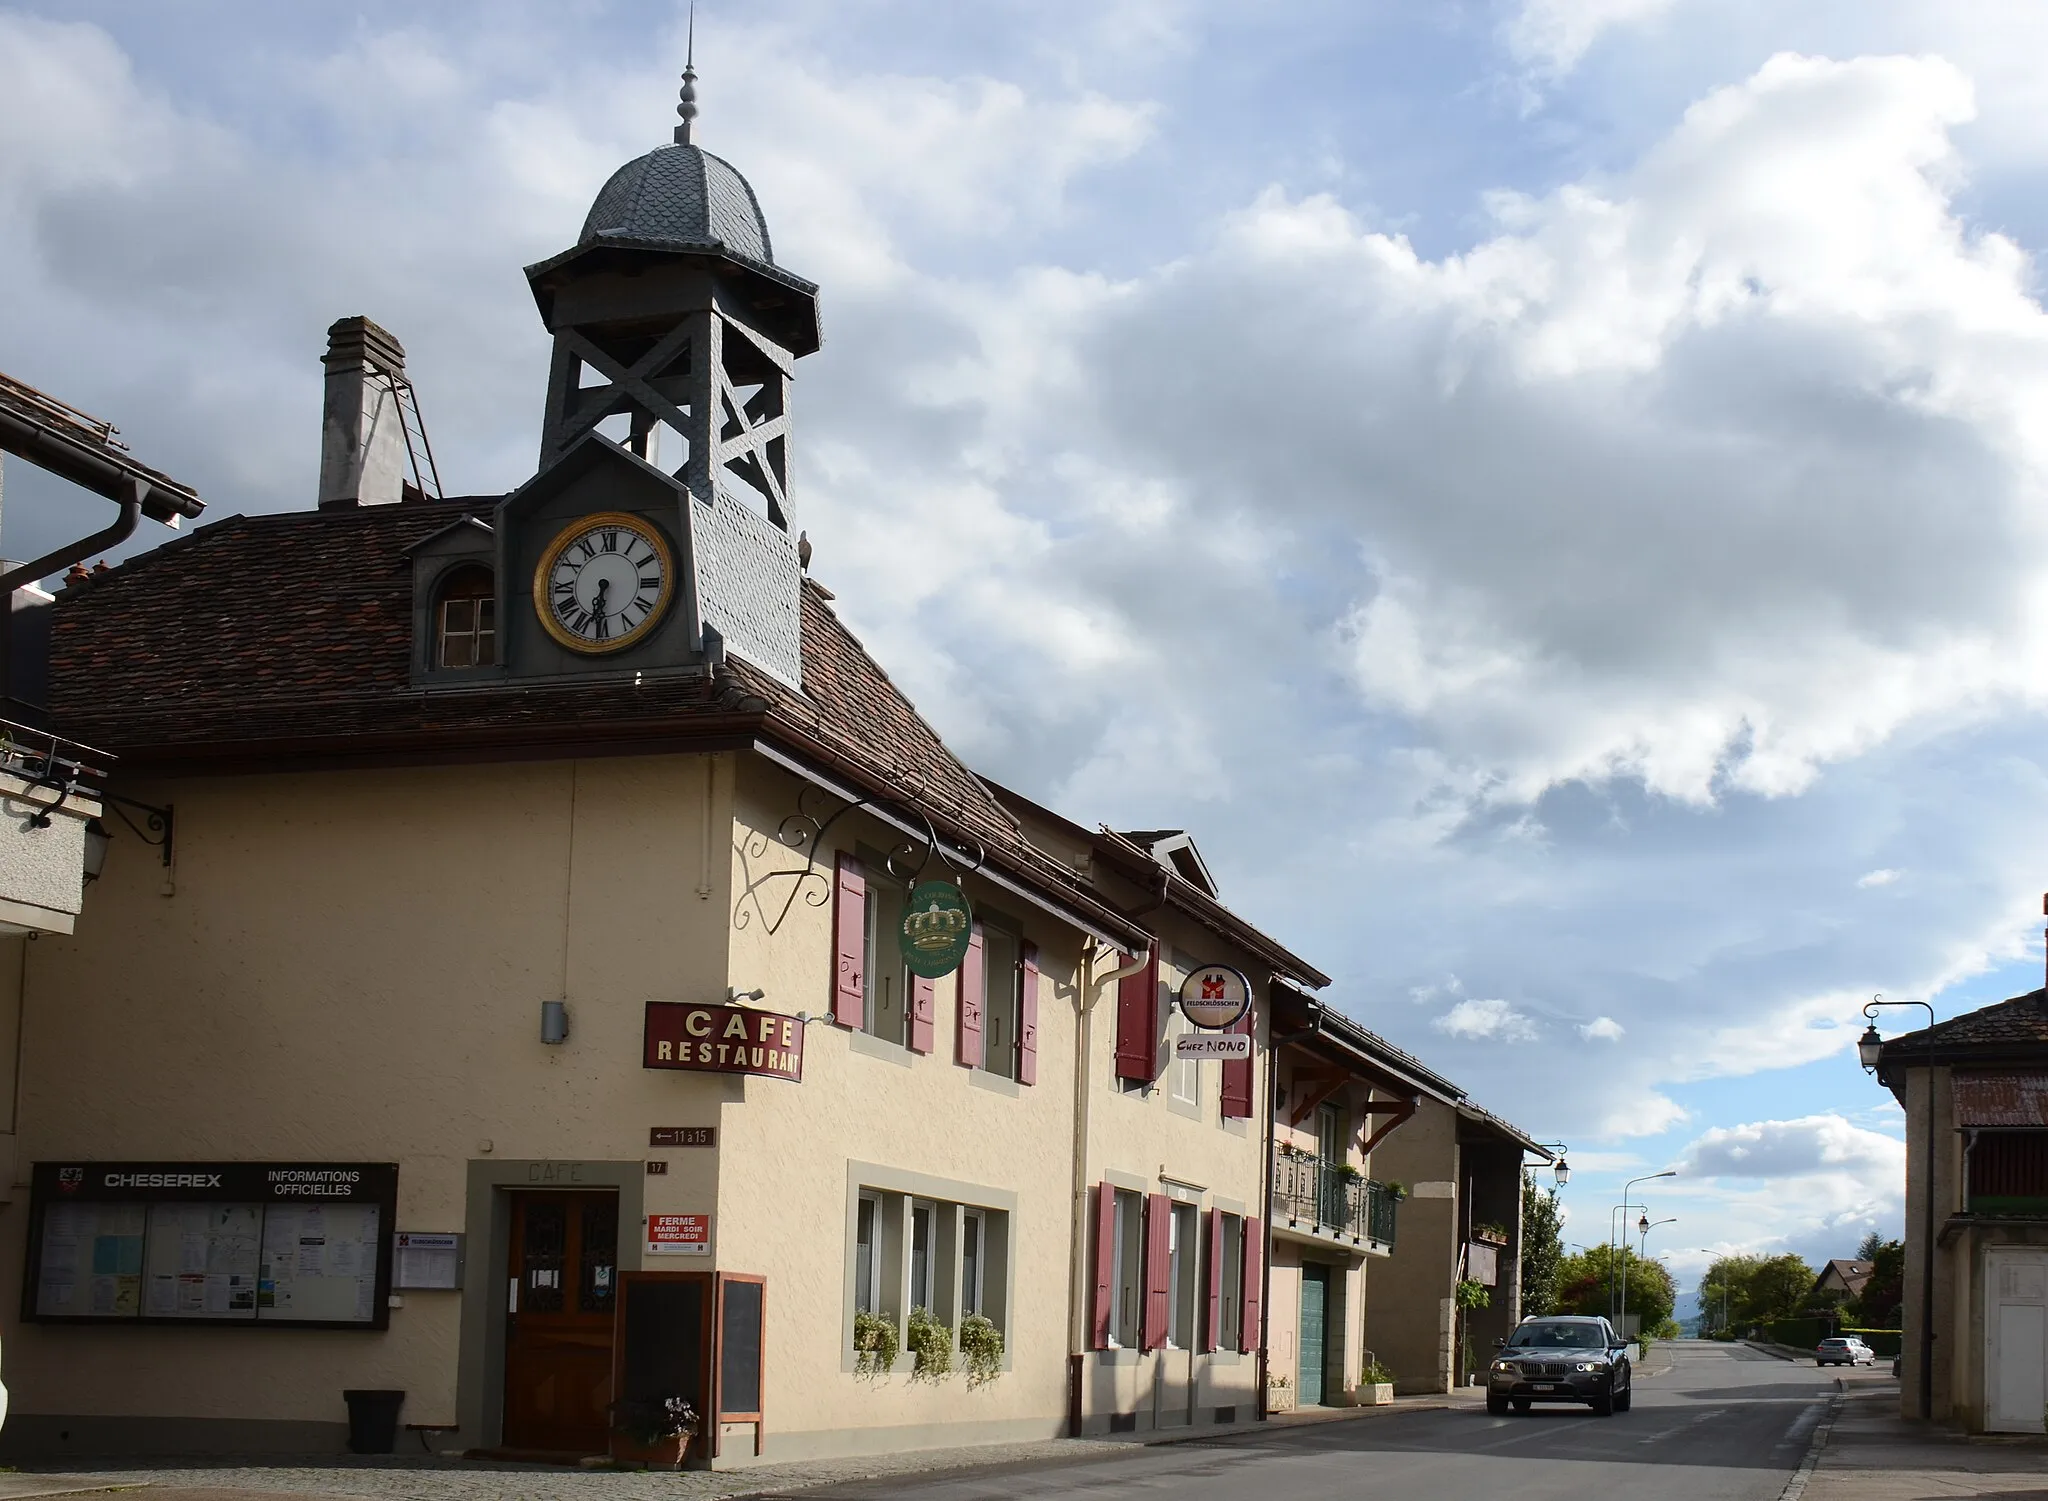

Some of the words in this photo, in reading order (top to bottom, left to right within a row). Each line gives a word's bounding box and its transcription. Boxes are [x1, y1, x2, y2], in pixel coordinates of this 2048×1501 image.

[577, 538, 596, 561] XI
[600, 532, 617, 553] XII
[624, 537, 638, 556] I
[561, 557, 582, 574] X
[636, 553, 656, 569] II
[554, 580, 574, 594] IX
[640, 577, 660, 589] III
[556, 595, 580, 621] VIII
[634, 596, 653, 615] IV
[621, 612, 635, 632] V
[685, 1010, 793, 1047] CAFE
[1207, 1041, 1246, 1052] NONO
[657, 1040, 799, 1074] RESTAURANT
[674, 1130, 685, 1143] 11
[695, 1130, 707, 1143] 15
[528, 1163, 584, 1182] CAFE
[652, 1163, 662, 1173] 17
[104, 1173, 222, 1188] CHESEREX
[268, 1171, 360, 1183] INFORMATIONS
[274, 1183, 352, 1196] OFFICIELLES
[659, 1217, 696, 1226] FERME
[657, 1232, 699, 1240] MERCREDI
